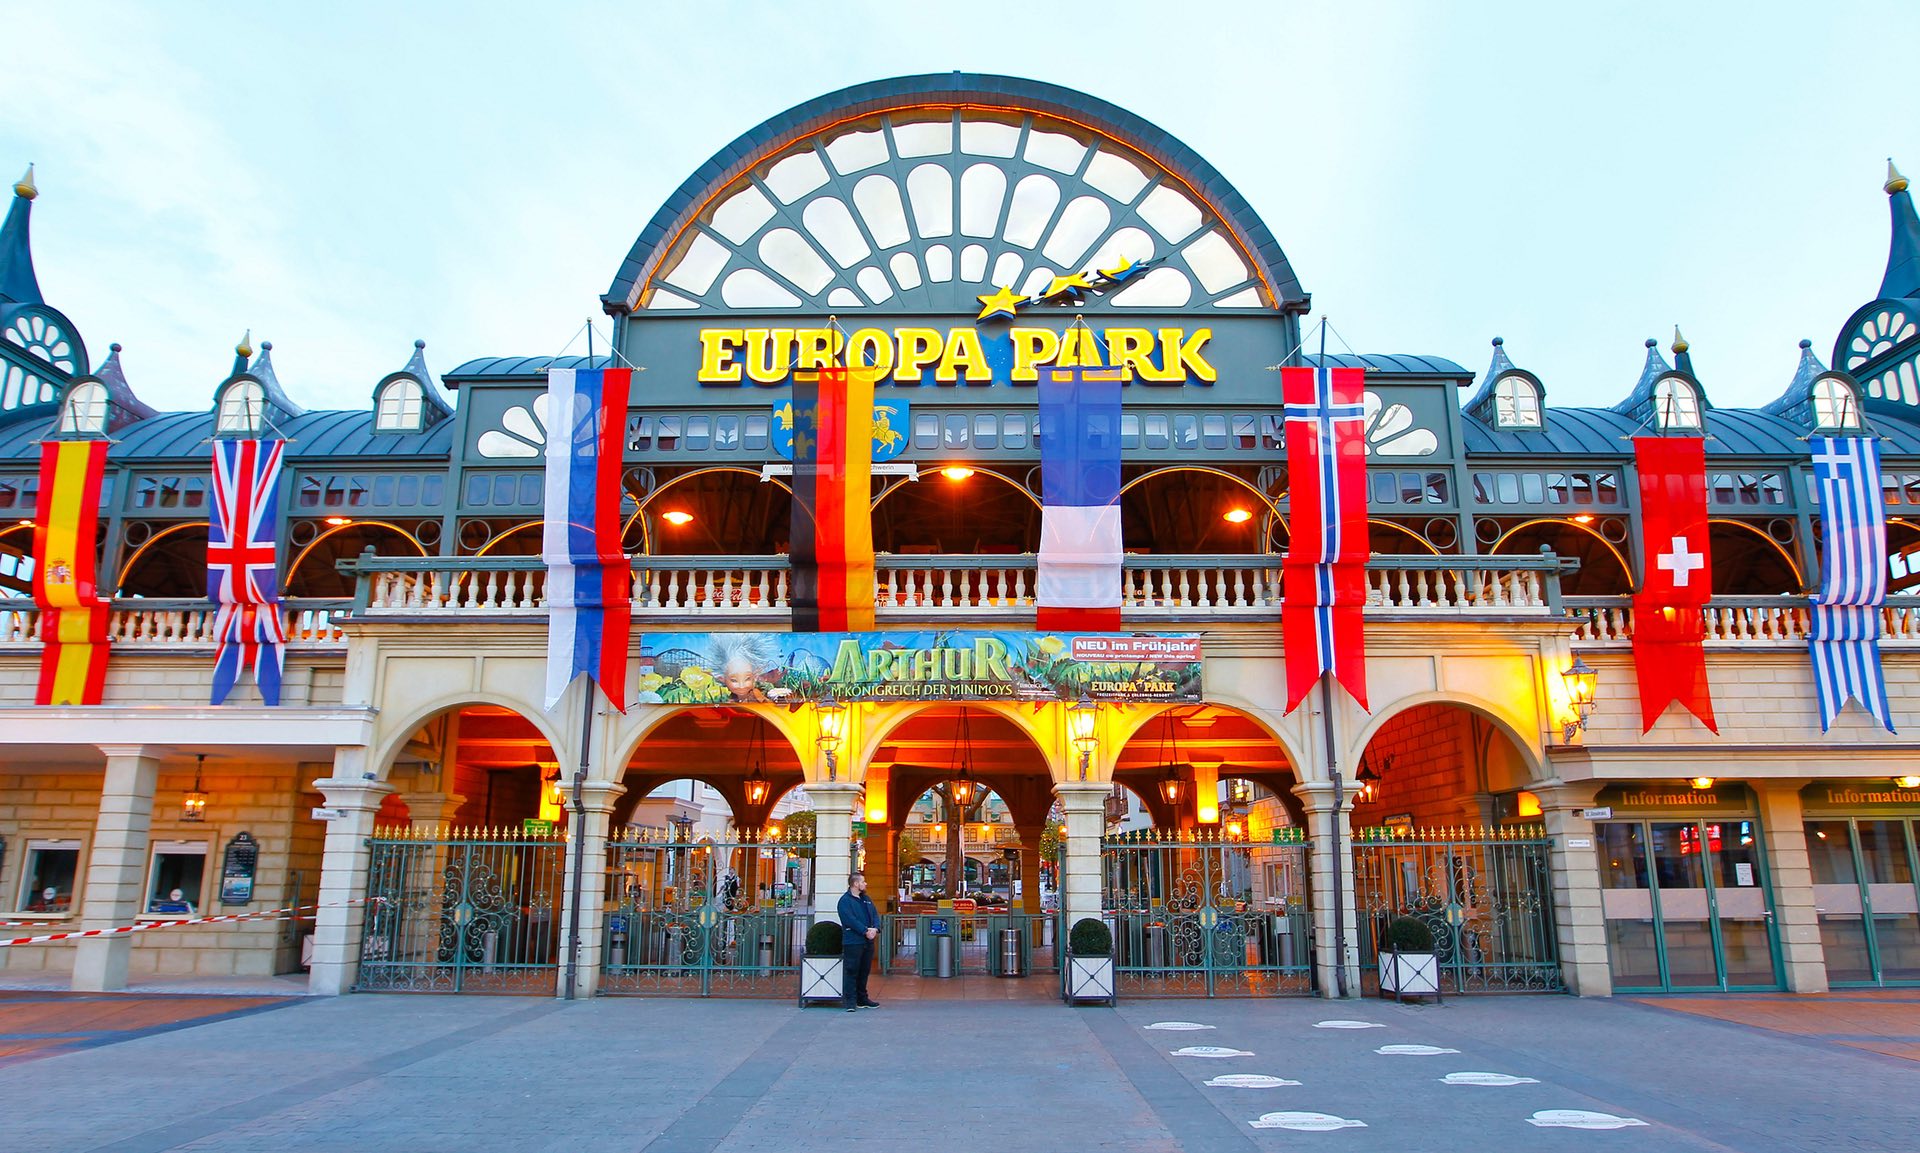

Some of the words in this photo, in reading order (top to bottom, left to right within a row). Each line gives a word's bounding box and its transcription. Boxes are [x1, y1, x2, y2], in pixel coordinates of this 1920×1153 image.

[697, 328, 993, 383] EUROPA
[1010, 327, 1217, 383] PARK
[1076, 641, 1107, 650] NEU
[1111, 641, 1129, 650] im
[1133, 641, 1197, 652] Frühjahr
[827, 637, 1012, 683] ARTHUR
[845, 683, 921, 697] KÖNIGREICH
[924, 684, 947, 696] DER
[950, 684, 1012, 696] MINIMOYS
[1091, 682, 1137, 692] EUROPA
[1144, 682, 1175, 692] PARK
[1622, 791, 1718, 805] Information
[1827, 789, 1920, 803] Information
